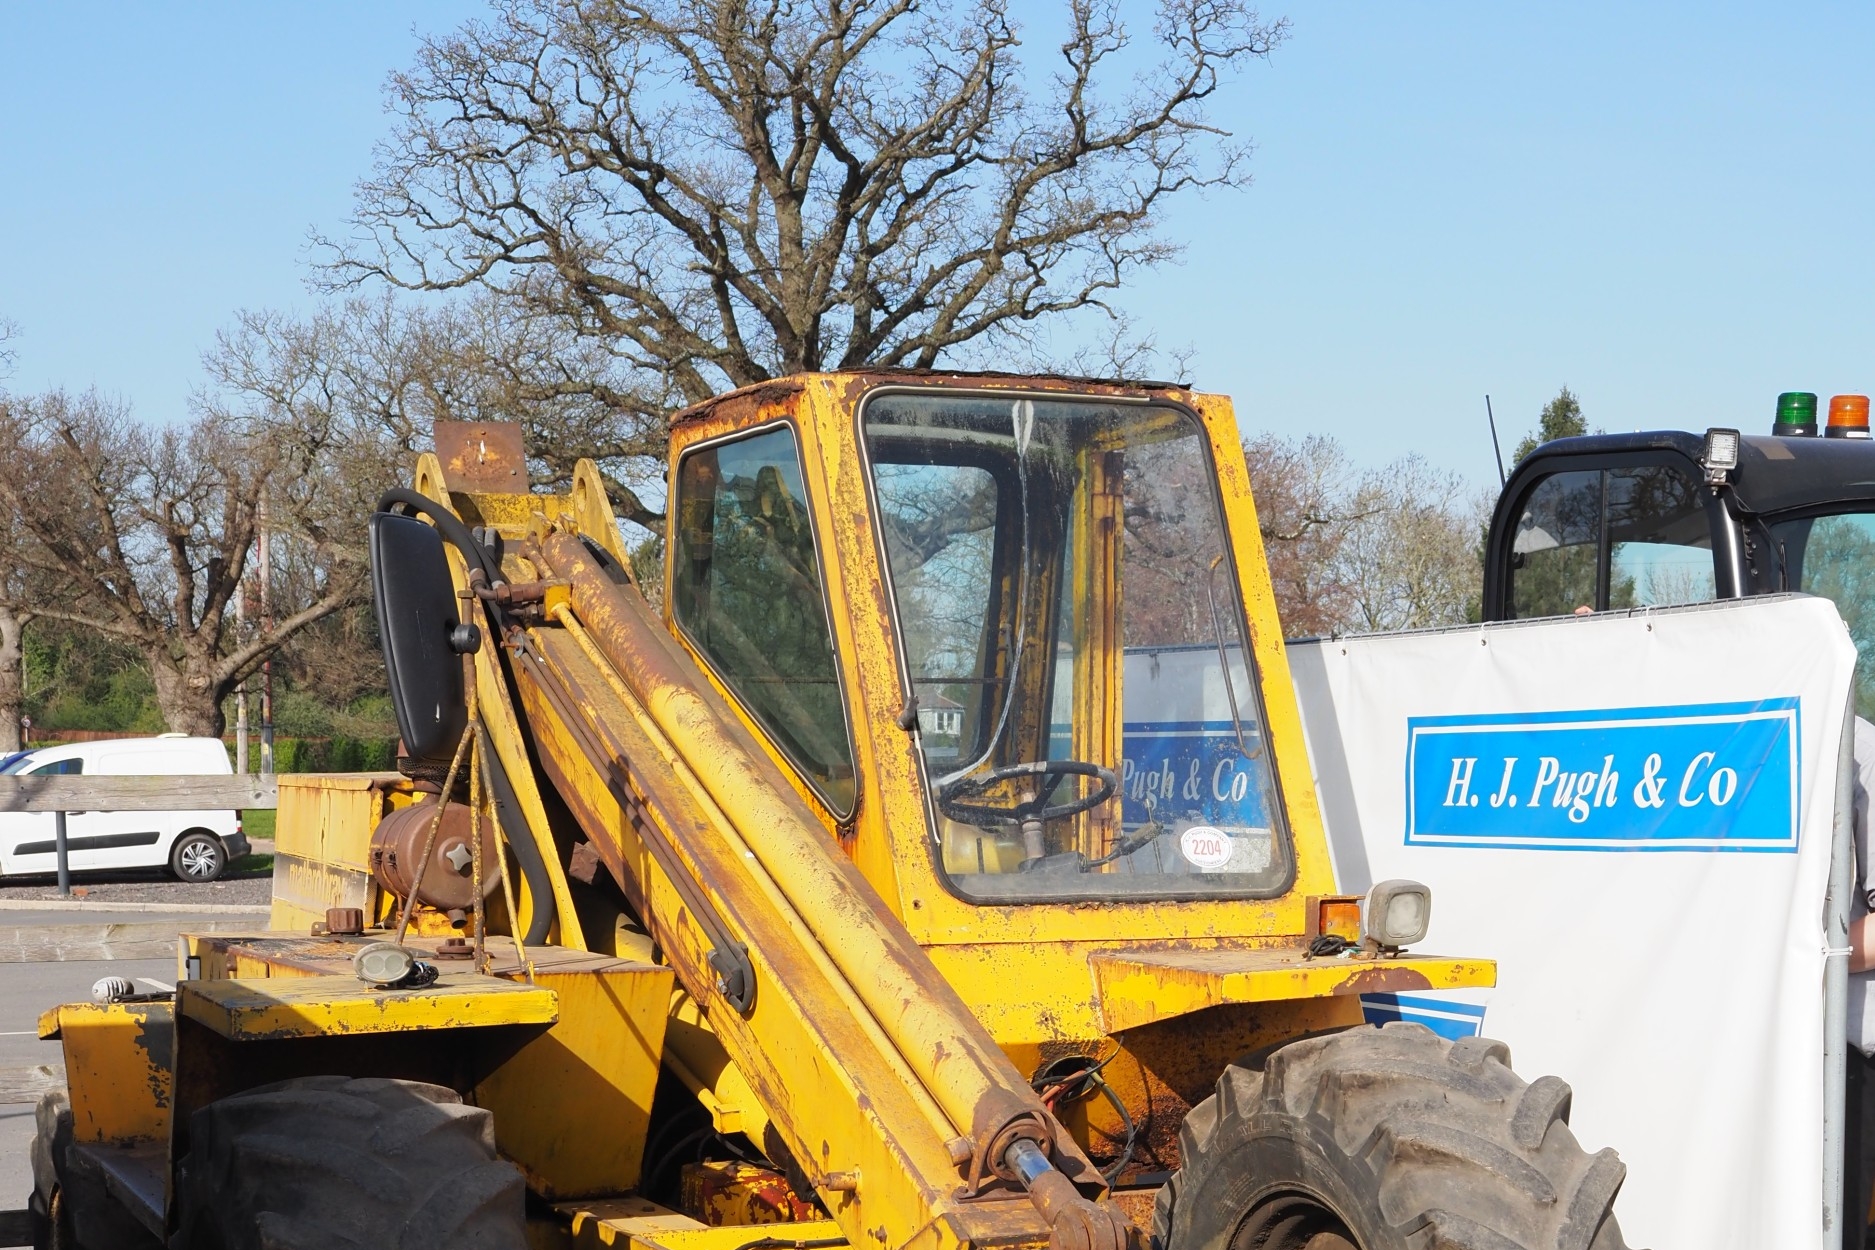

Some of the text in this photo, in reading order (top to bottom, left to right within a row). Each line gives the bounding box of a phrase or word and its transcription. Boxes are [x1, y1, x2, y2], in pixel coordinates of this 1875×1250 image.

[1122, 757, 1248, 811] Pugh & Co
[1442, 751, 1739, 824] H. J. Pugh & Co
[1191, 839, 1222, 856] 2204
